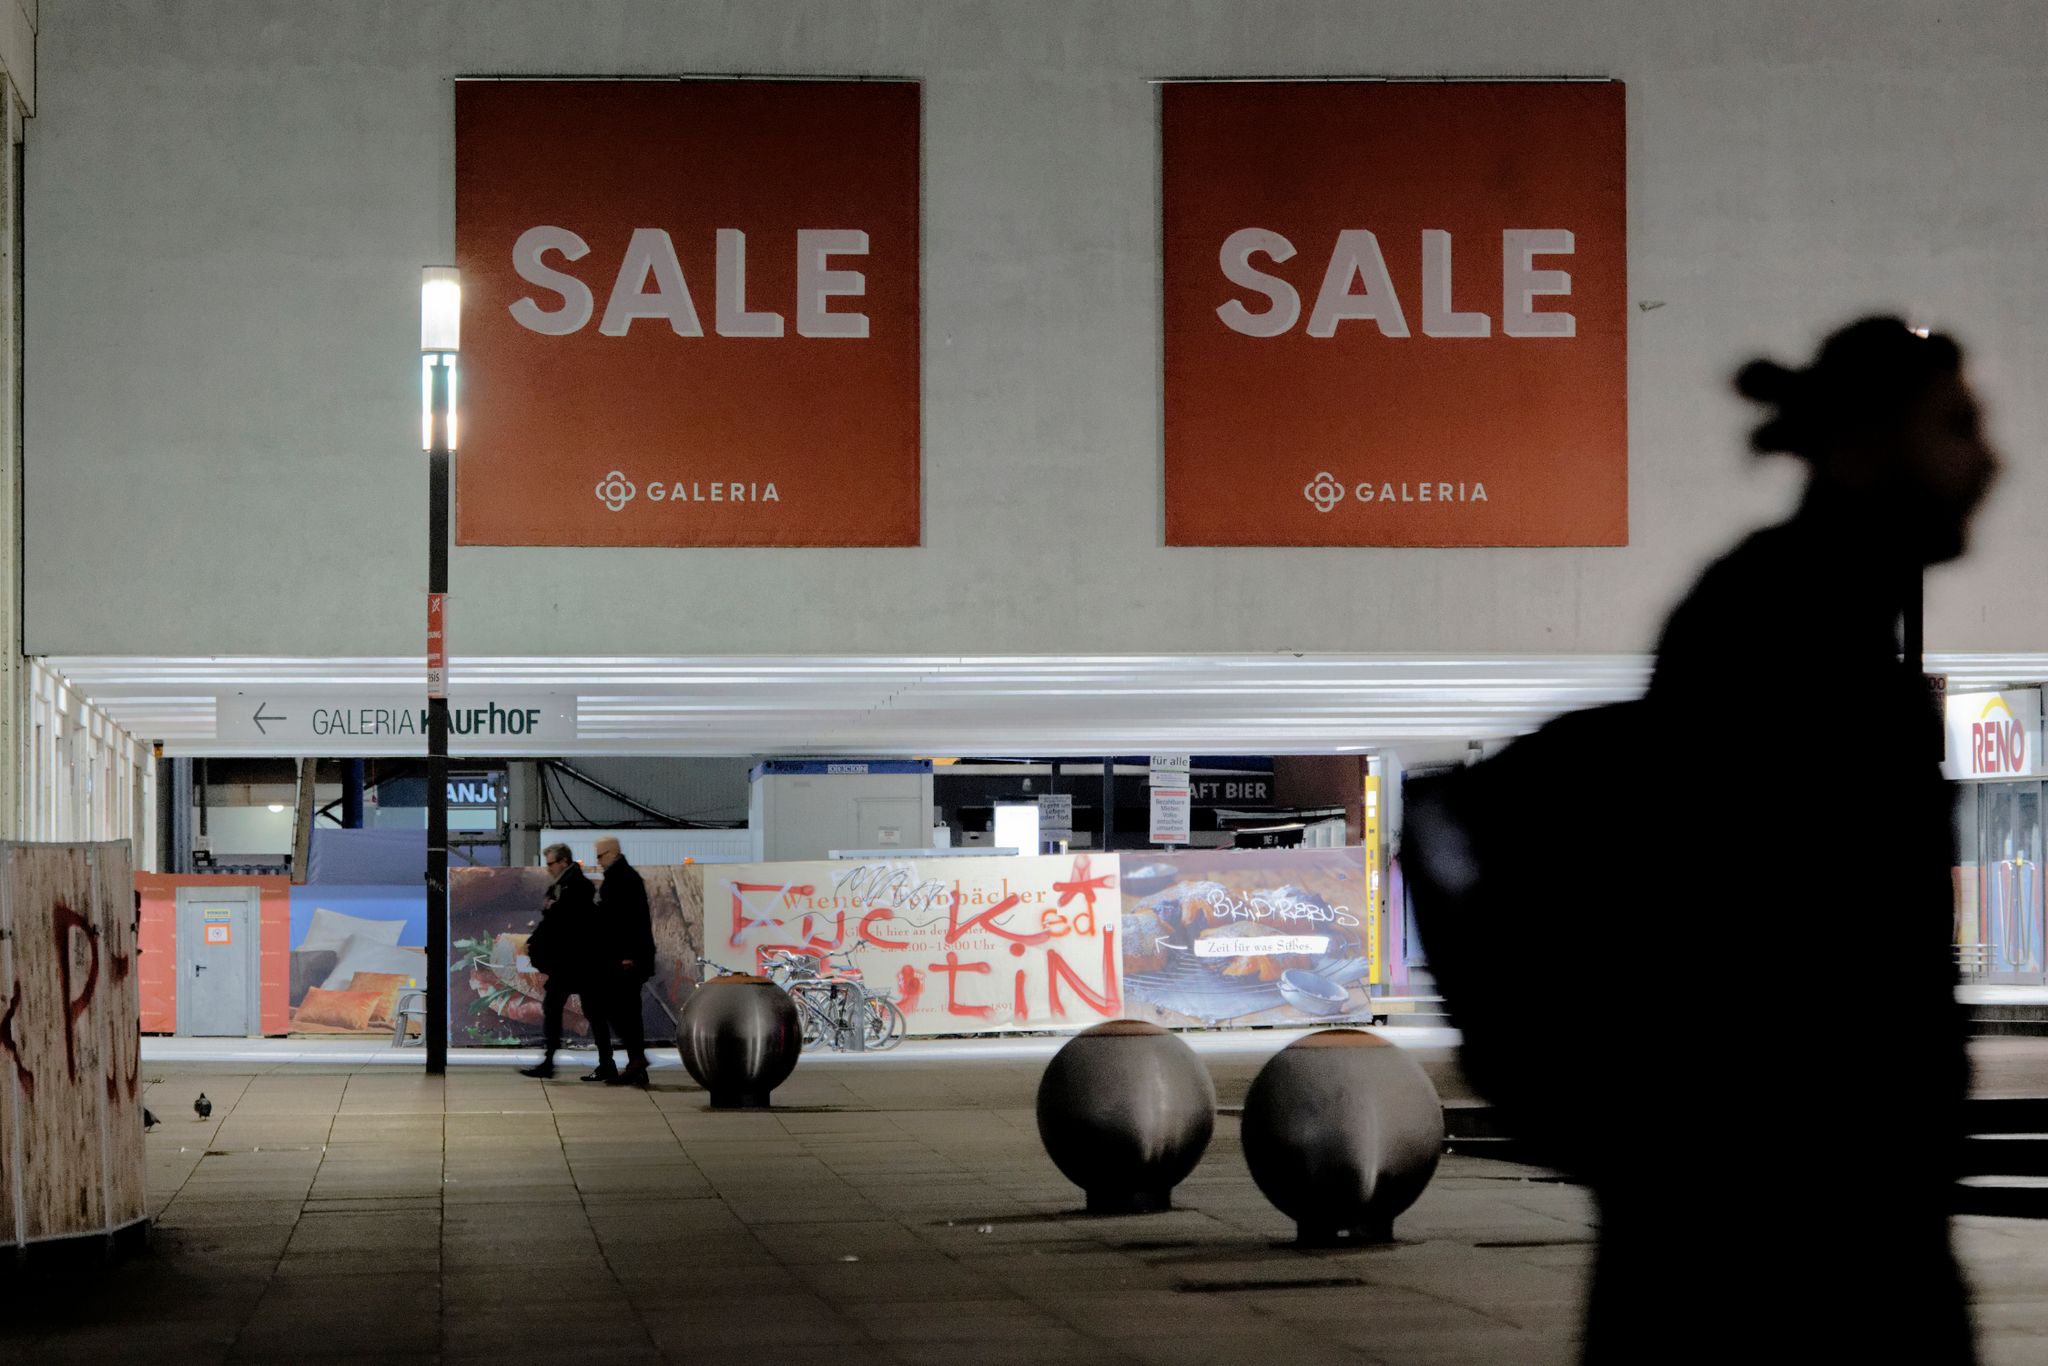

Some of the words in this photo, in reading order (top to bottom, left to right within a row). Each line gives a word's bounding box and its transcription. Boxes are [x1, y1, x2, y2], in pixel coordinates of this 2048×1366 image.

[508, 225, 870, 338] SALE
[1215, 227, 1576, 338] SALE
[647, 481, 780, 502] GALERIA
[1355, 481, 1489, 502] GALERIA
[312, 709, 415, 735] GALERIA
[1972, 719, 2025, 774] RENO
[1152, 755, 1167, 766] für
[1170, 756, 1188, 767] alle
[1225, 783, 1267, 799] BIER
[887, 924, 908, 937] hier
[912, 928, 926, 936] an
[974, 938, 997, 951] Uhr
[1208, 940, 1230, 953] Zeit
[1234, 938, 1250, 952] für
[1254, 944, 1273, 952] was
